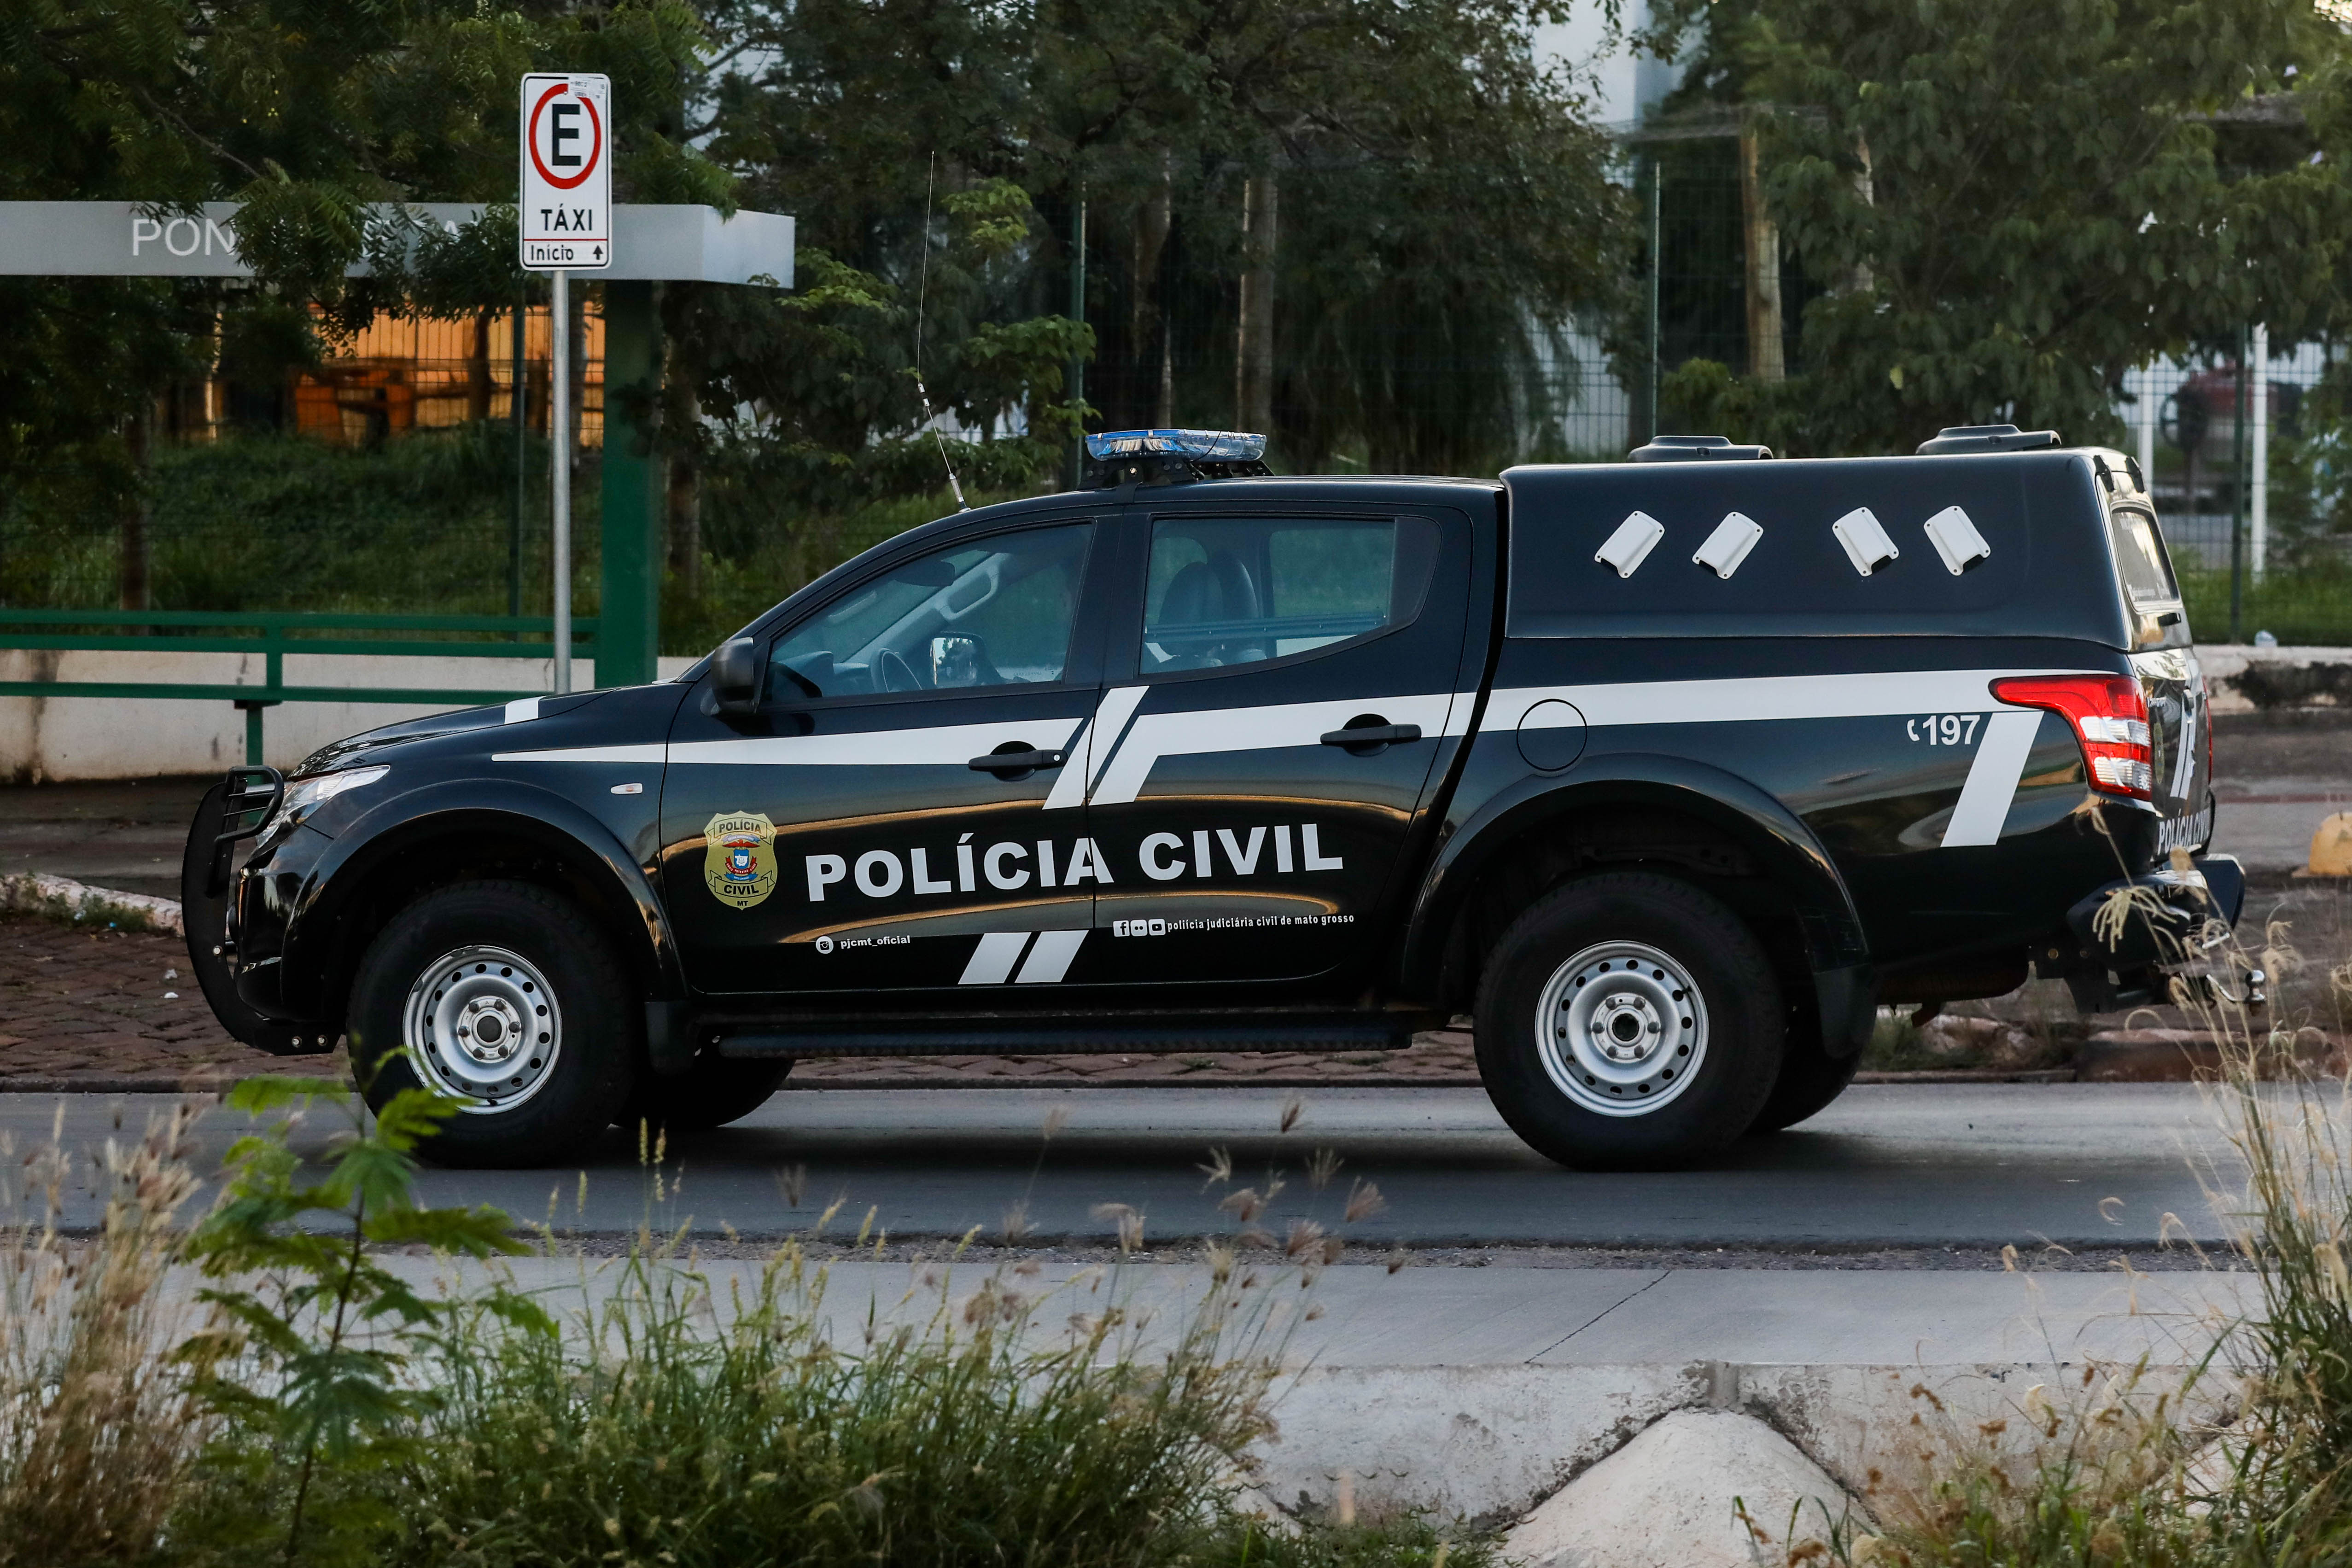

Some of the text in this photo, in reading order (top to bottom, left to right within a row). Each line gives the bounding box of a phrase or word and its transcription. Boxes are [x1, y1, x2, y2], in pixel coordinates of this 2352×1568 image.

[552, 104, 582, 166] E
[541, 204, 592, 231] TÁXI
[133, 218, 238, 256] PON
[531, 245, 573, 261] Início
[1923, 715, 1980, 746] 197
[719, 819, 762, 834] POLÍCIA
[806, 823, 1343, 902] POLÍCIA CIVIL
[724, 884, 759, 895] CIVIL
[1207, 917, 1254, 931] judiciária
[1256, 915, 1278, 926] civil
[1280, 915, 1291, 925] de
[1295, 915, 1318, 924] mato
[1321, 915, 1354, 926] grosso
[840, 935, 911, 949] pjcmt_oficial
